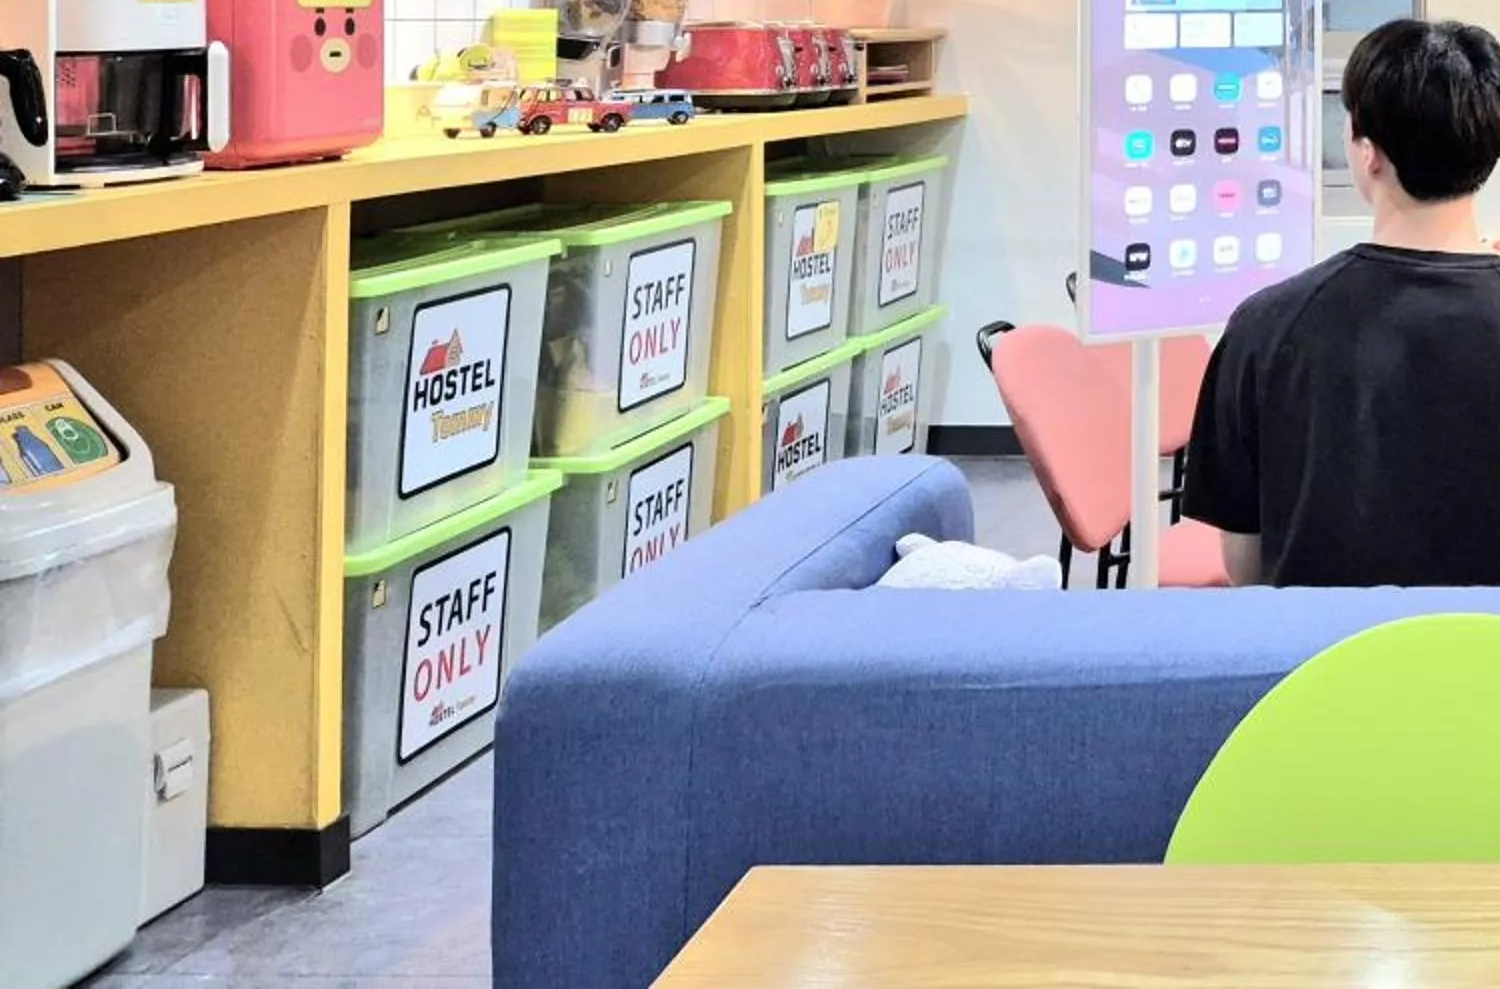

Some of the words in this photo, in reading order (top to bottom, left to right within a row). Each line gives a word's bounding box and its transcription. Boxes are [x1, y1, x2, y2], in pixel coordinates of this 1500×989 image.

[887, 207, 919, 240] STAFF
[793, 253, 831, 280] HOSTEL
[632, 273, 686, 320] STAFF
[629, 317, 681, 366] ONLY
[413, 359, 496, 412] HOSTEL
[777, 432, 822, 474] HOSTEL
[633, 478, 685, 537] STAFF
[417, 571, 497, 648] STAFF
[413, 624, 492, 702] ONLY
